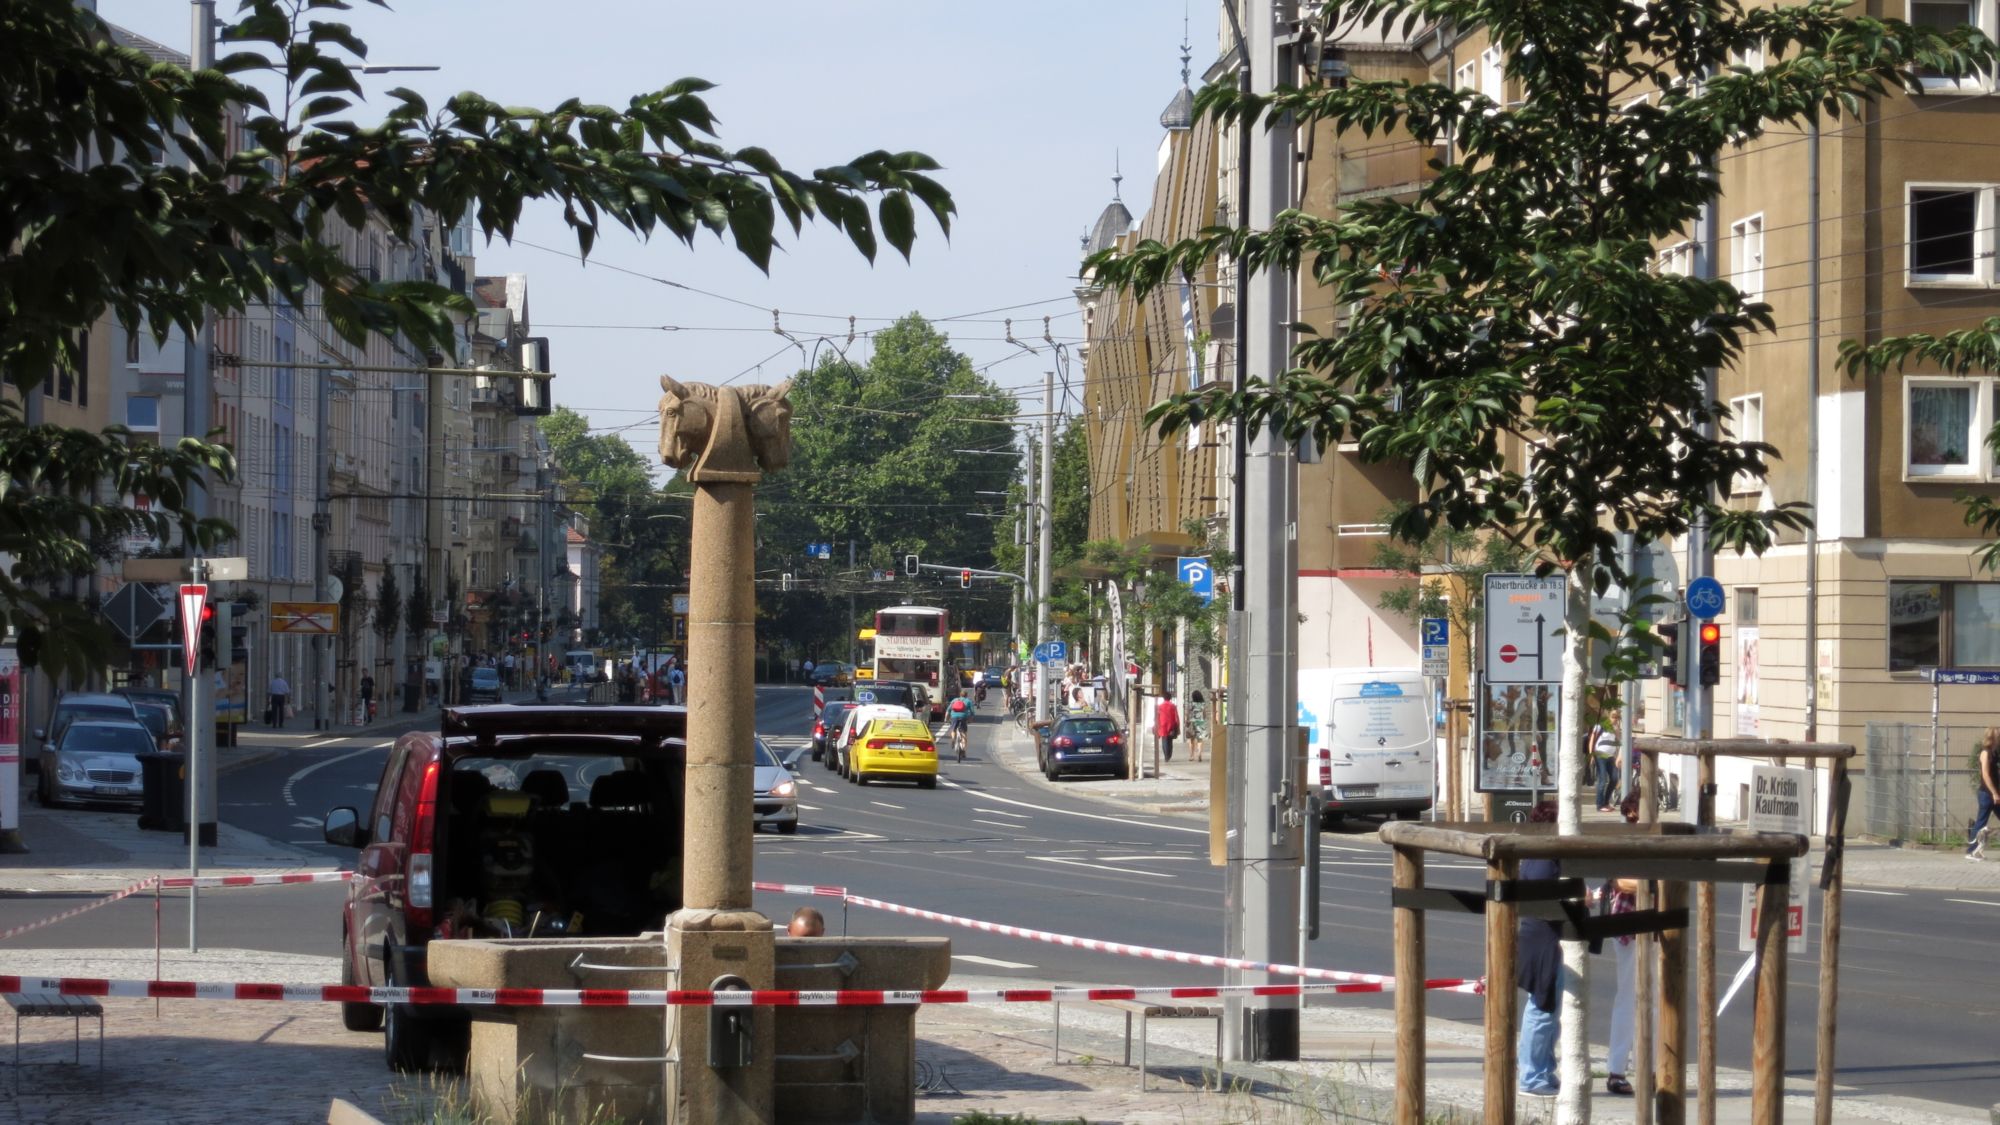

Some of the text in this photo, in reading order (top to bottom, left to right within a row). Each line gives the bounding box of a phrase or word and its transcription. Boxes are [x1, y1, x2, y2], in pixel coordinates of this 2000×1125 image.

[1190, 568, 1204, 585] P
[1490, 580, 1538, 590] Albertbrücke
[1425, 621, 1441, 642] P
[1050, 643, 1060, 657] P
[1757, 775, 1798, 797] Dr. Kristin
[1755, 795, 1799, 817] Kaufmann
[374, 989, 400, 998] BayWa
[798, 993, 824, 1001] BayWa
